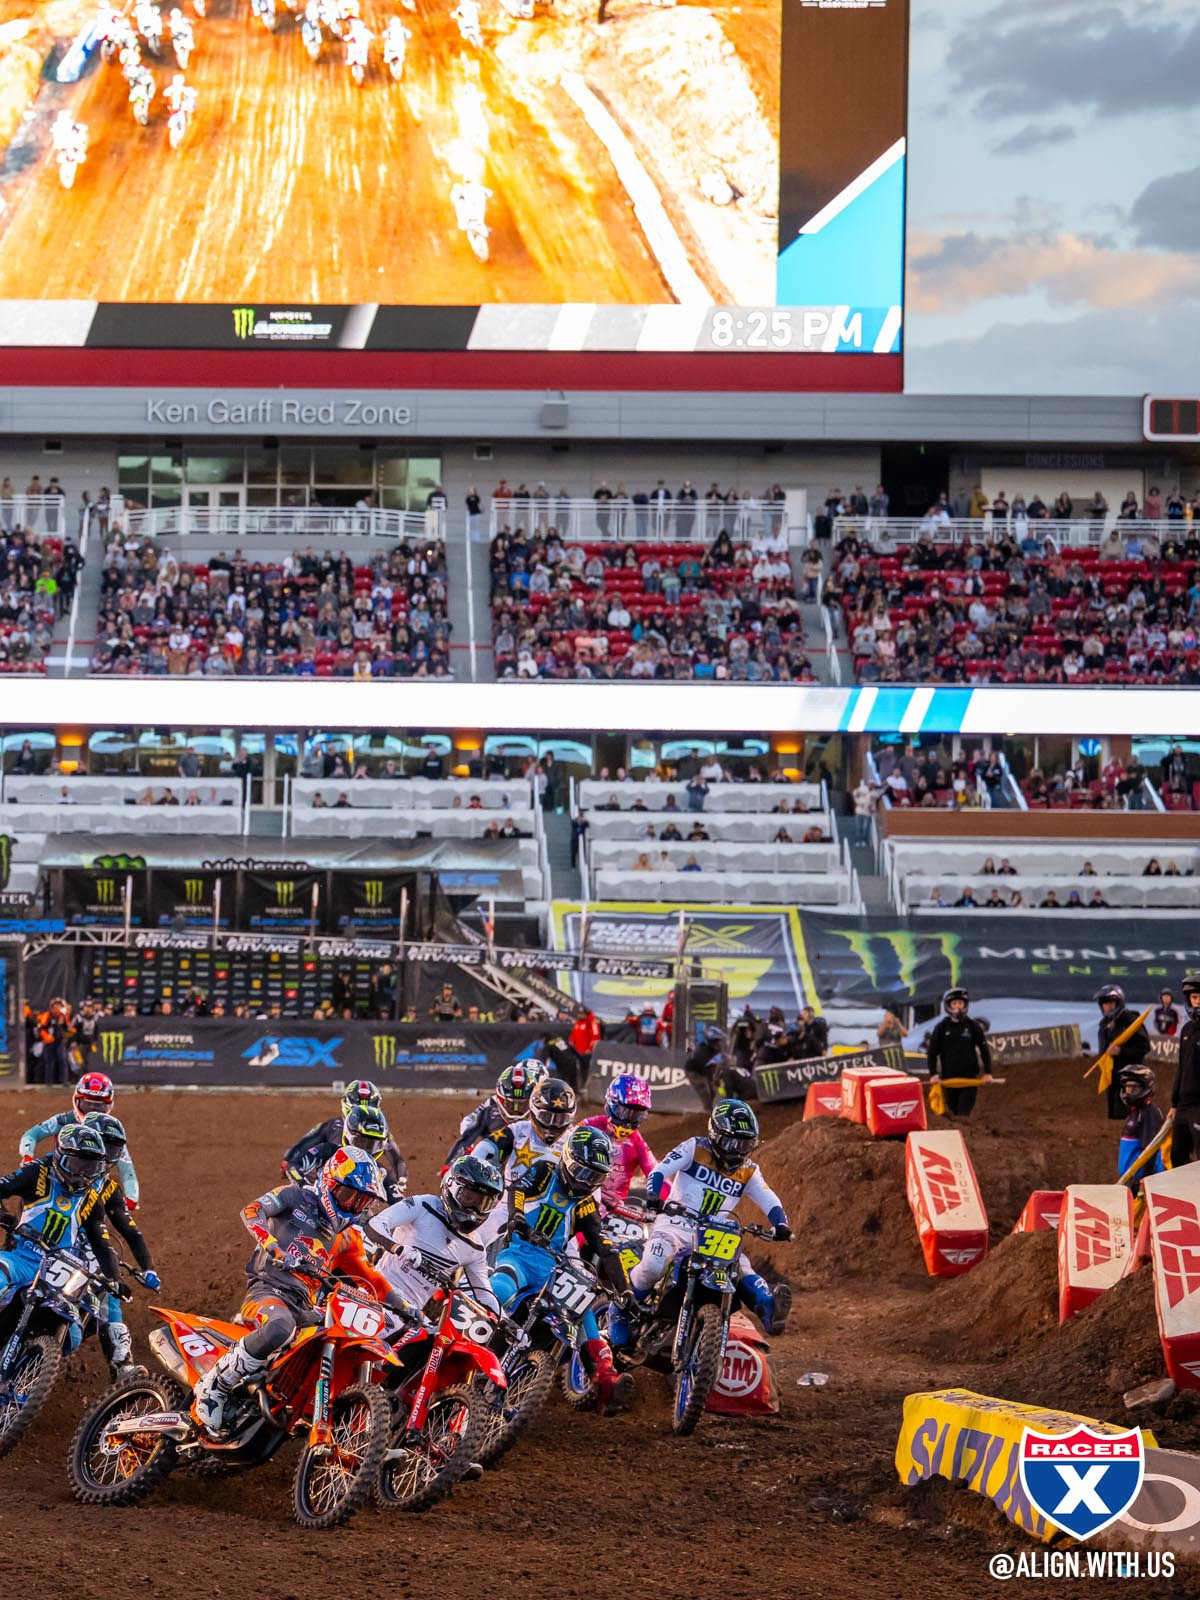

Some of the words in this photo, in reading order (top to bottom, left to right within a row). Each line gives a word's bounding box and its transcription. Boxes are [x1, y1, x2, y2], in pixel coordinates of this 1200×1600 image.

[711, 312, 792, 347] 8:25
[804, 312, 862, 347] PM
[147, 400, 198, 424] Ken
[207, 400, 274, 424] Garff
[282, 400, 335, 424] Red
[343, 400, 411, 424] Zone
[977, 944, 1200, 961] MONST
[987, 1032, 1043, 1050] NSTER
[597, 1059, 686, 1082] TRIUMP
[787, 1054, 877, 1082] MONSTER
[35, 1164, 48, 1198] THOR
[695, 1165, 742, 1197] DNGR
[918, 1145, 962, 1215] FLY
[80, 1188, 99, 1221] THOR
[698, 1229, 742, 1260] 38
[1073, 1197, 1112, 1272] FLY
[552, 1271, 596, 1315] 511
[337, 1301, 383, 1336] 16
[450, 1304, 494, 1344] 30
[678, 1310, 688, 1346] DUNLOP
[2, 1334, 19, 1371] DUNLOP
[181, 1336, 215, 1357] 16
[720, 1320, 729, 1357] DUNLOP
[412, 1386, 426, 1422] DUNLOP
[907, 1418, 1047, 1535] SUZUK
